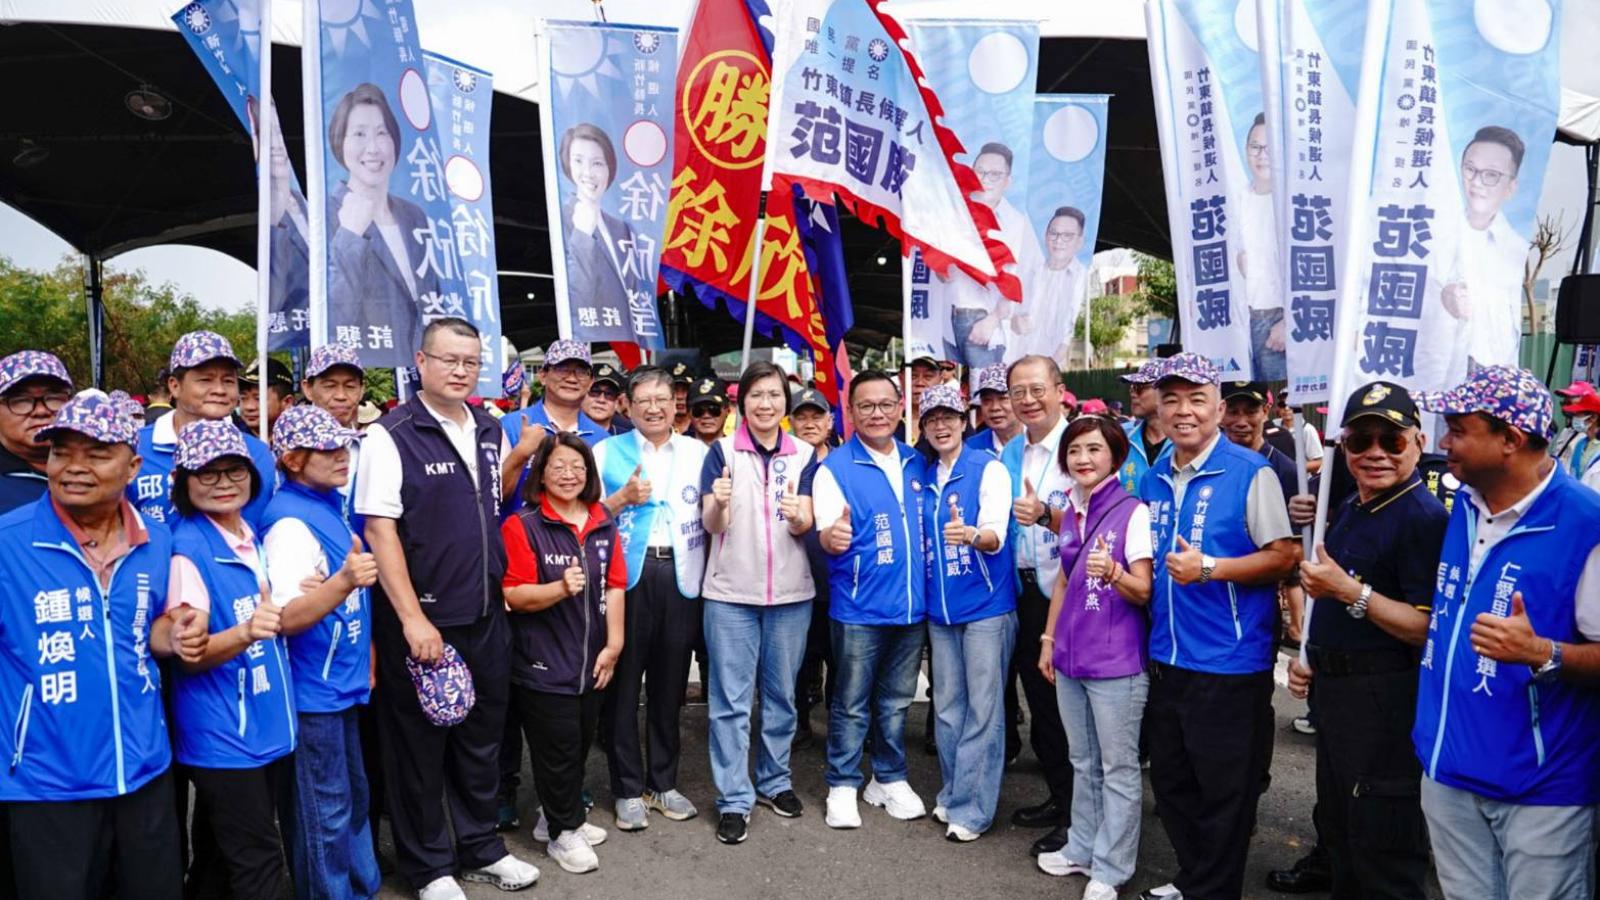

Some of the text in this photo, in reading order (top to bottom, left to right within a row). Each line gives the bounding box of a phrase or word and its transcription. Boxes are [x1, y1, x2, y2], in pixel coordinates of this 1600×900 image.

[694, 61, 770, 158] 勝
[801, 66, 924, 145] 竹東鎮長候選人
[790, 100, 916, 194] 范國威
[425, 462, 456, 476] KMT
[545, 554, 571, 566] KMT
[874, 513, 894, 565] 范國威
[33, 588, 78, 705] 鍾煥明
[75, 586, 95, 641] 候選人
